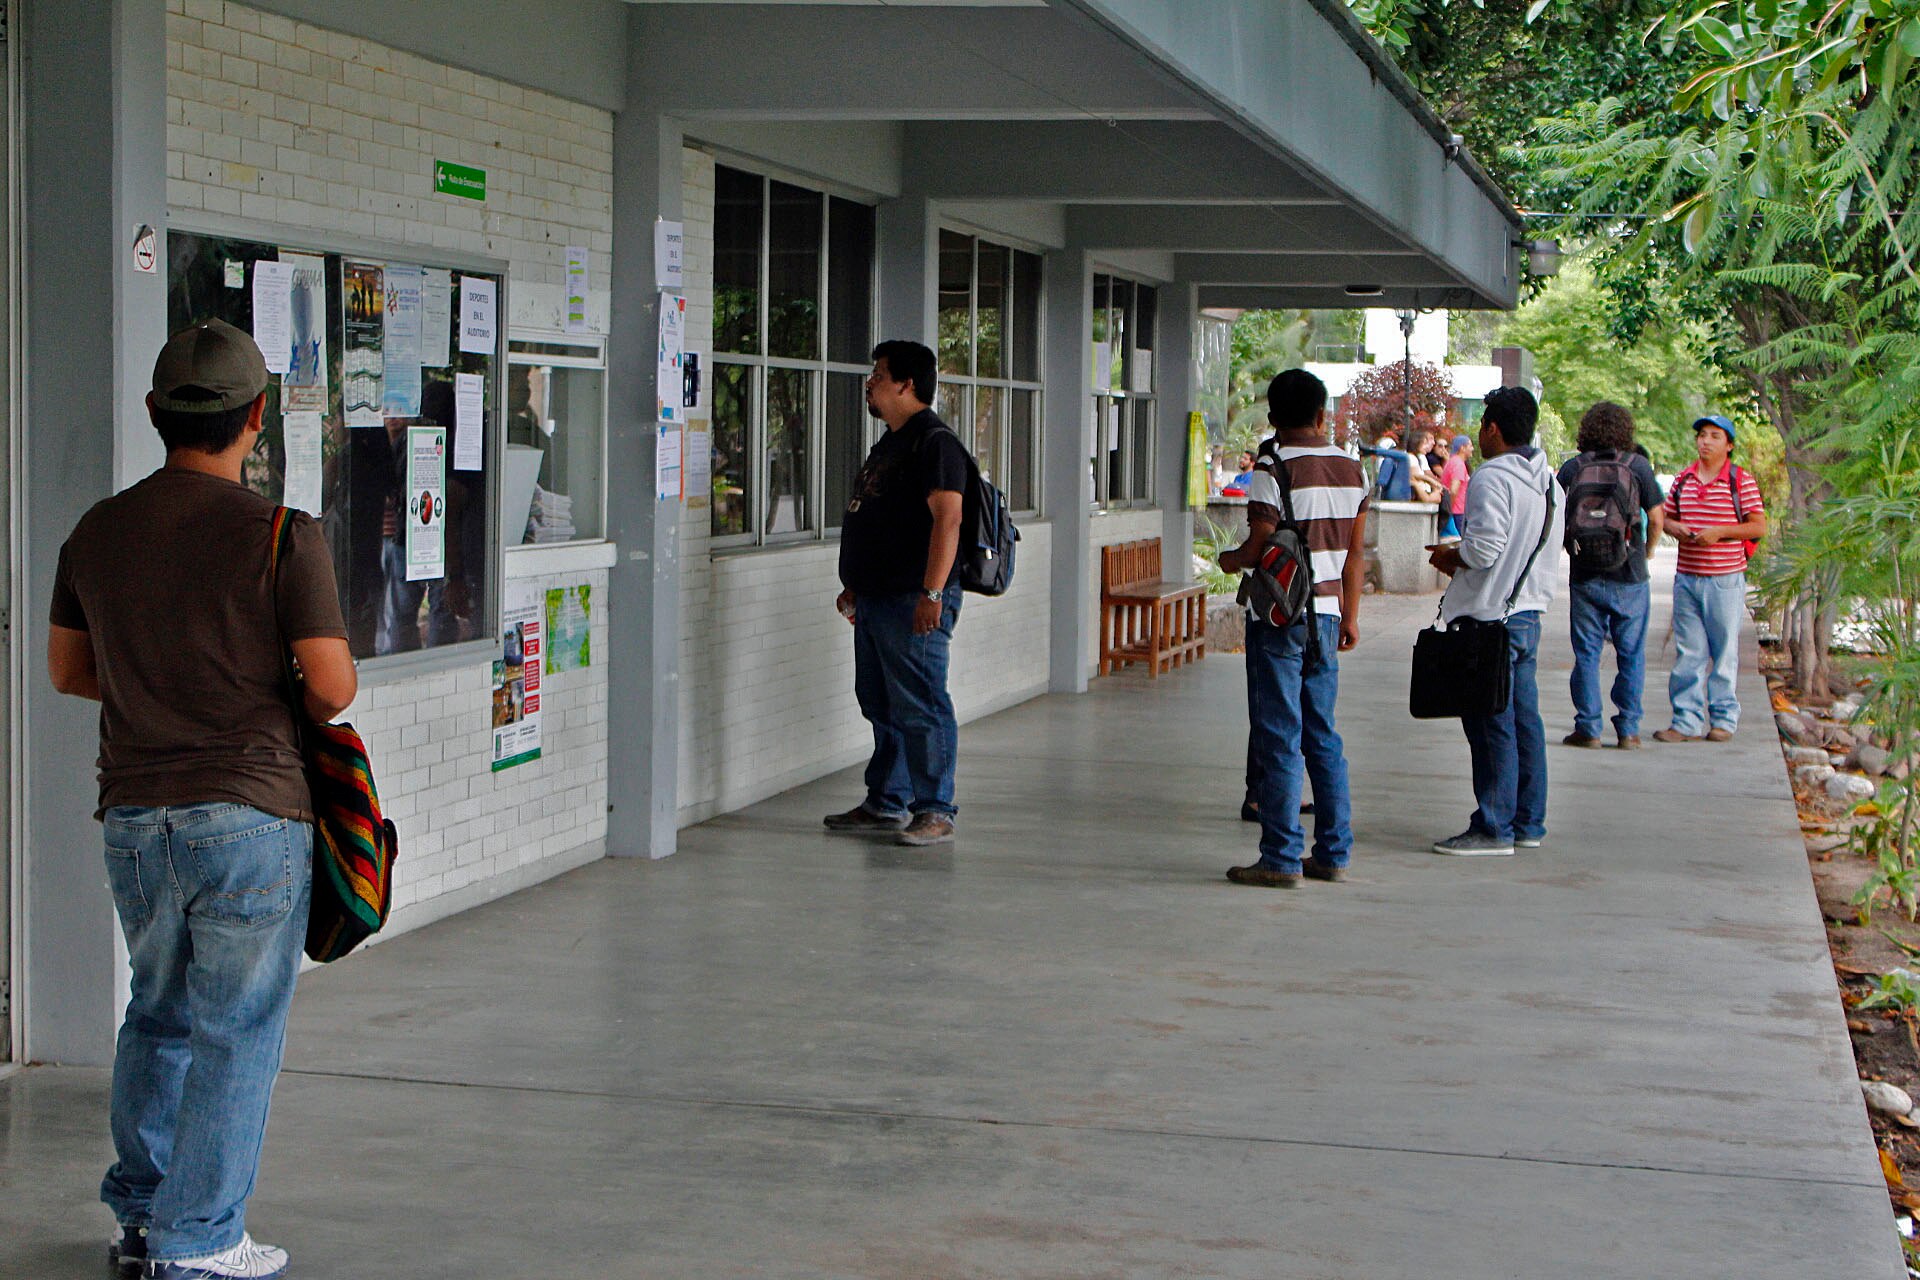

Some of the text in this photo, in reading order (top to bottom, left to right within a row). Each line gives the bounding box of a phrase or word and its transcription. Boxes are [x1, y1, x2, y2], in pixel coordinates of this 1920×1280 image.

[469, 292, 489, 304] DEPORTES
[473, 311, 484, 320] EN EL
[467, 327, 490, 339] AUDITORIO
